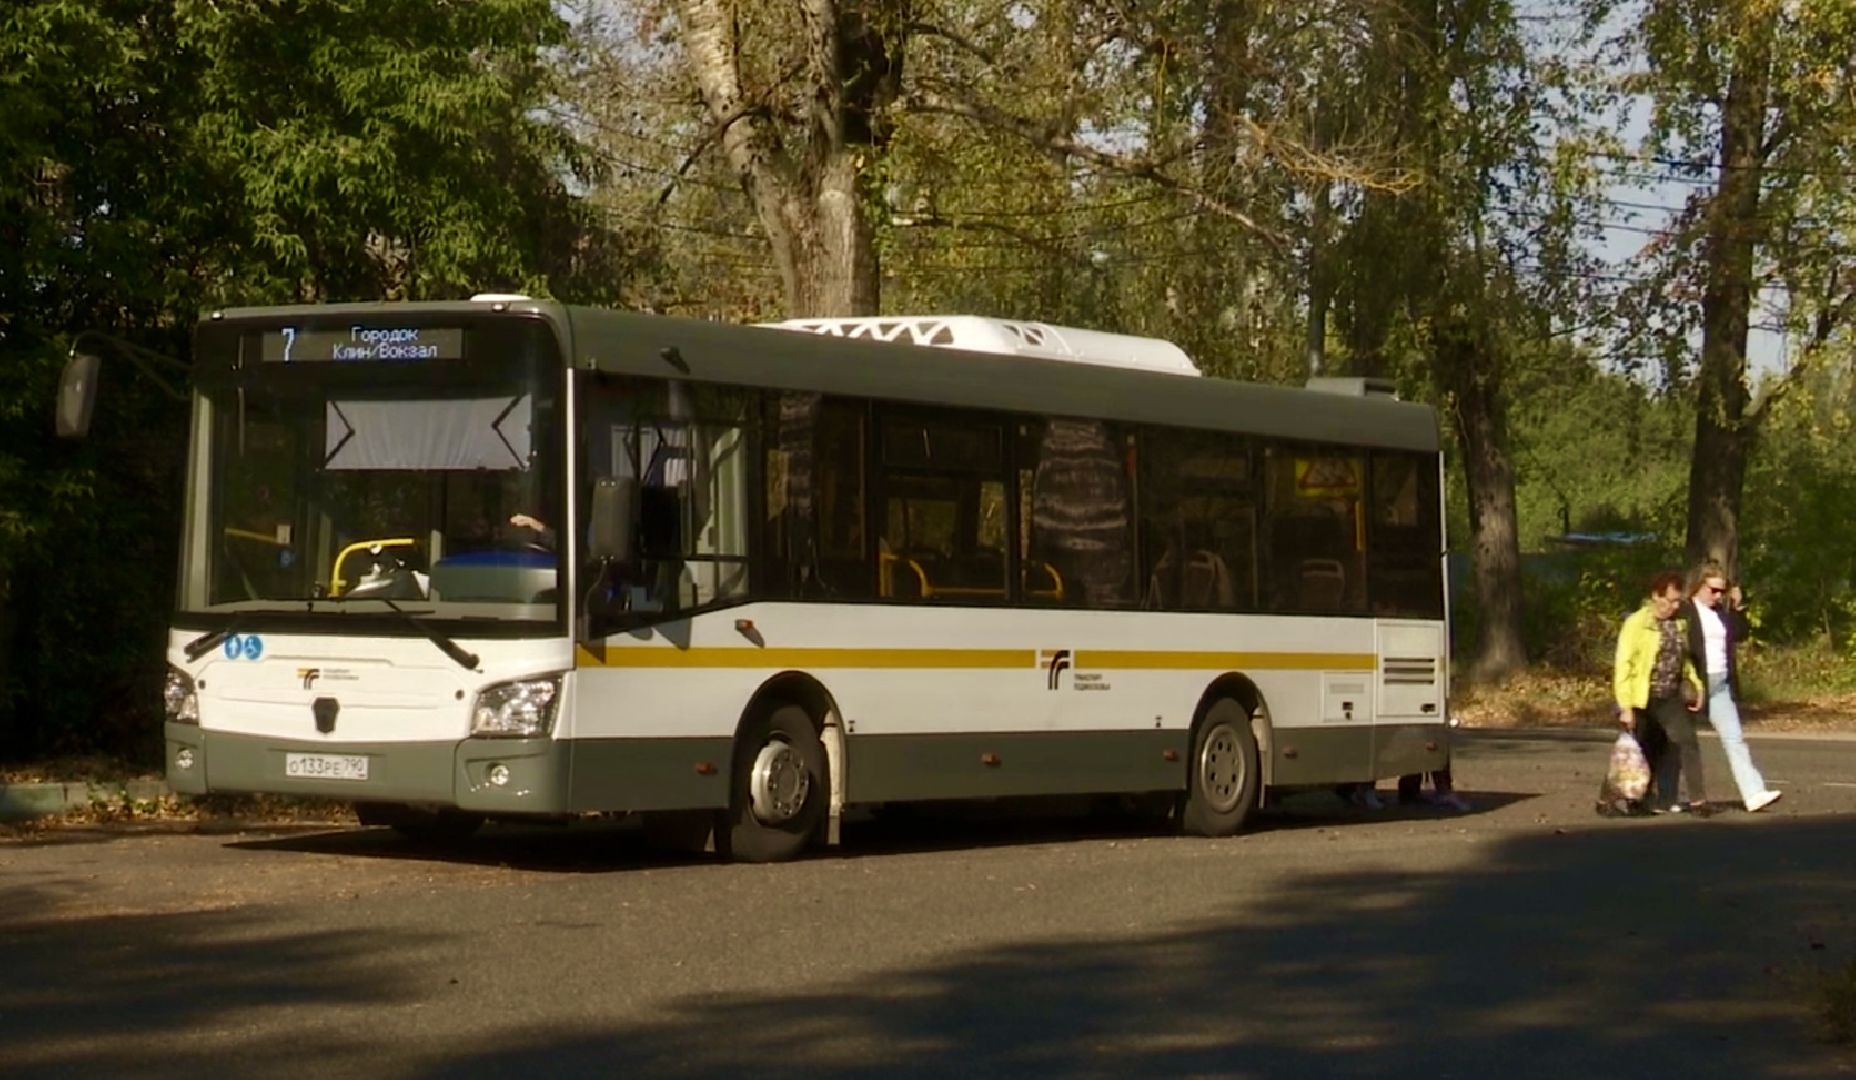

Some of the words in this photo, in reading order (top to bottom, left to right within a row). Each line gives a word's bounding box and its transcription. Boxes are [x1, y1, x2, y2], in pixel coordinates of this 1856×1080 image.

[282, 327, 295, 362] 7
[351, 326, 419, 345] Городок
[333, 342, 438, 360] Клин/Вокзал
